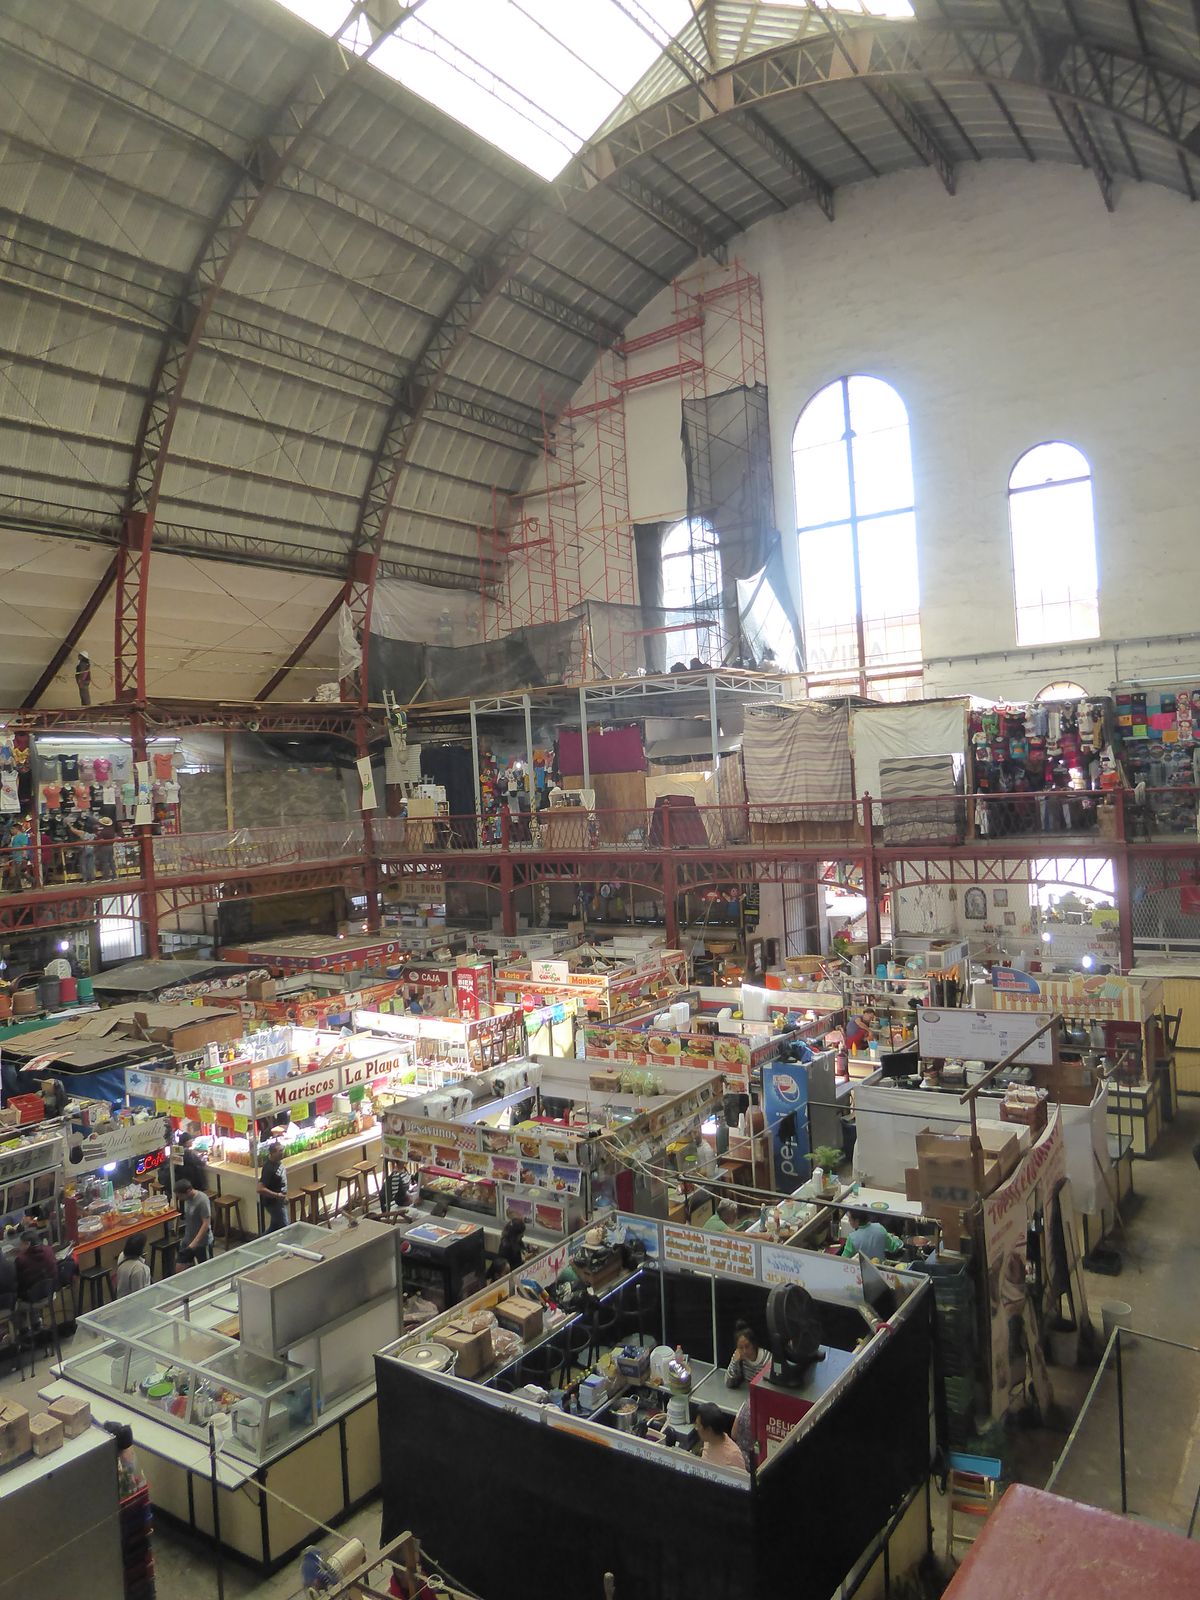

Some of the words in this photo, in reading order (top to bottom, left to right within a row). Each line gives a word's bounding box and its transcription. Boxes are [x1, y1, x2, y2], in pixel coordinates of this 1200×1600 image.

[405, 883, 417, 894] EL
[420, 883, 442, 895] TORO
[421, 973, 440, 983] CAJA
[275, 1078, 335, 1107] Mariscos
[344, 1062, 362, 1086] La
[365, 1058, 400, 1081] Playa
[403, 1118, 458, 1140] Desayunos
